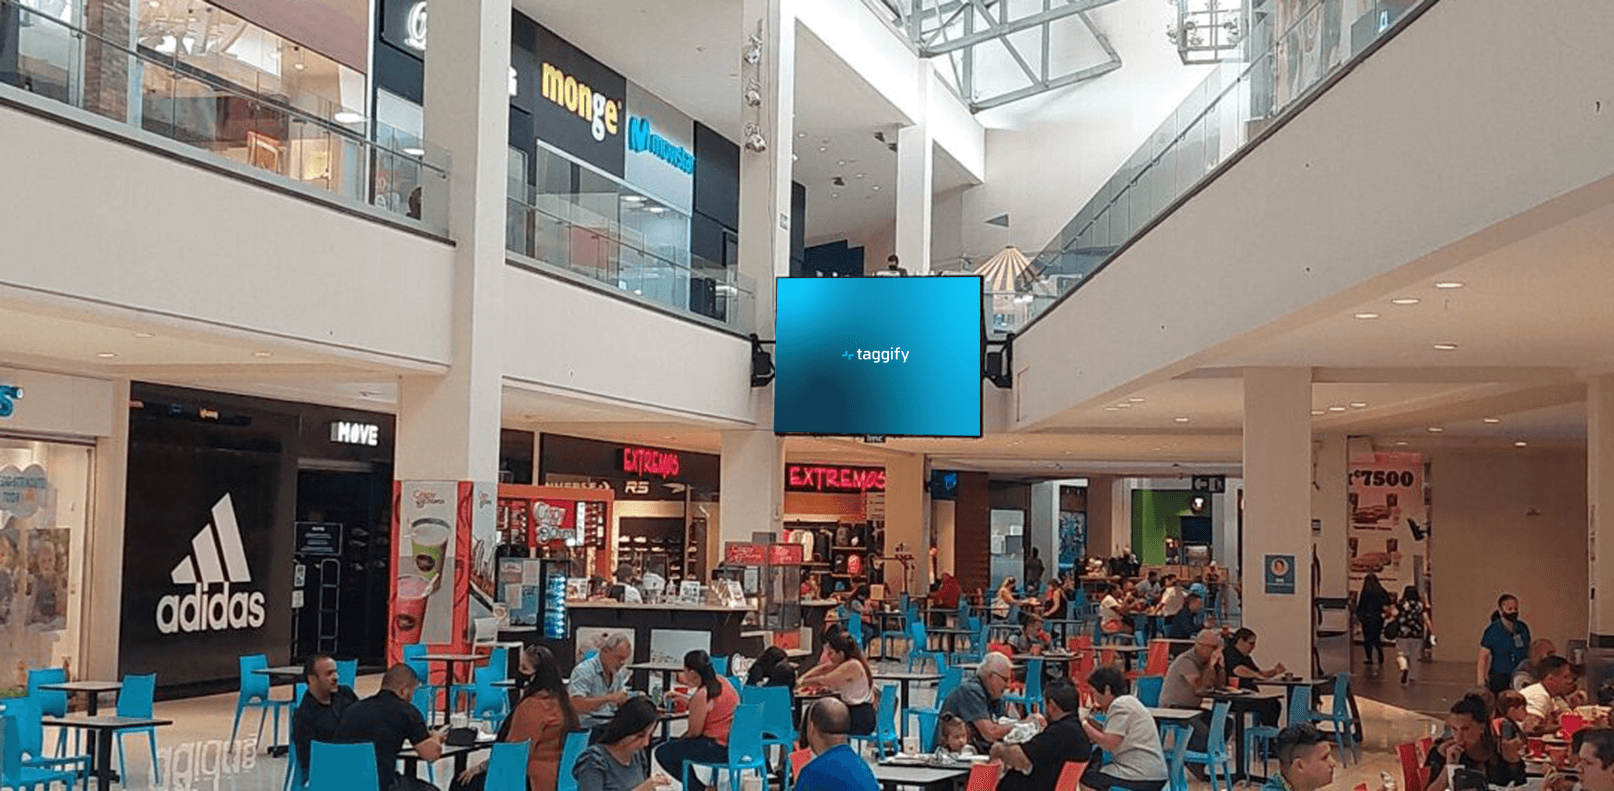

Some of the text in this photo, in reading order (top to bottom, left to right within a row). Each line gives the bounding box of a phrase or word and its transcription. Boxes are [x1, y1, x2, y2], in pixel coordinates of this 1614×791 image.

[541, 62, 618, 141] monge
[857, 346, 909, 363] taggify
[156, 582, 265, 634] adidas
